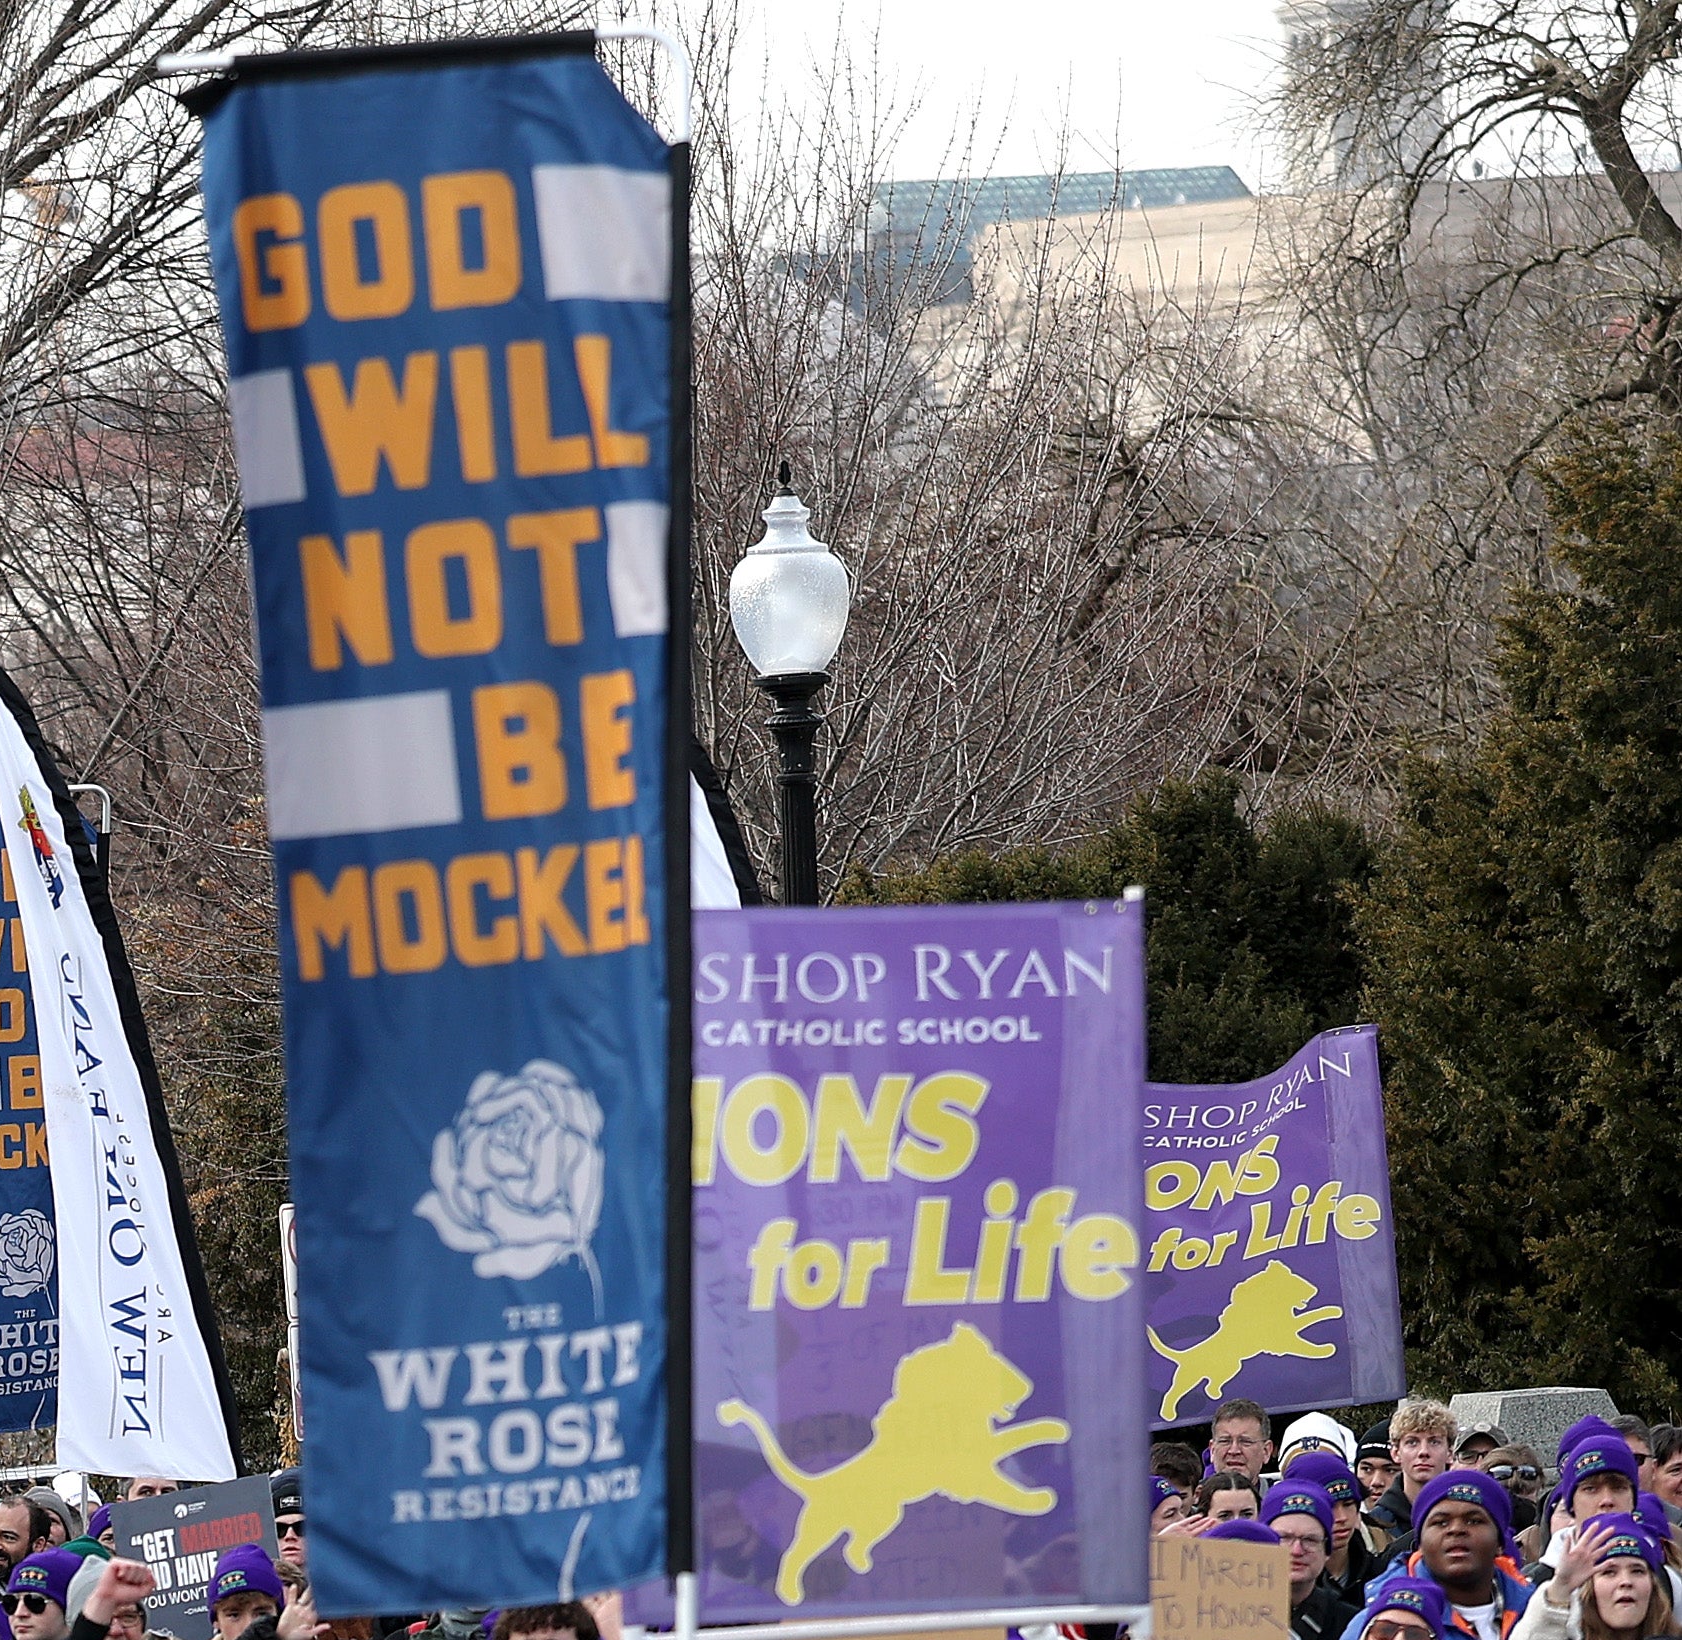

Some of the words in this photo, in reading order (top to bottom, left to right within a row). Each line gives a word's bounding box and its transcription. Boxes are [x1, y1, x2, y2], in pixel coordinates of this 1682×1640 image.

[233, 169, 521, 332] GOD
[305, 334, 649, 496] WILL
[300, 506, 600, 671] NOT
[472, 670, 635, 821] BE
[696, 951, 886, 1004] SHOP
[915, 944, 1113, 1001] RYAN
[702, 1019, 885, 1047] CATHOLIC
[897, 1015, 1041, 1044] SCHOOL
[8, 1055, 43, 1110] B
[1144, 1101, 1258, 1129] SHOP
[1265, 1052, 1351, 1113] RYAN
[1252, 1097, 1306, 1137] SCHOOL
[693, 1071, 991, 1187] IONS
[1145, 1135, 1280, 1211] ONS
[747, 1218, 889, 1310] for
[902, 1180, 1138, 1306] Life
[1147, 1228, 1238, 1272] for
[1243, 1181, 1381, 1261] Life
[14, 1309, 36, 1319] THE
[502, 1304, 561, 1331] THE
[367, 1322, 644, 1412] WHITE
[1151, 1539, 1165, 1581] I
[1180, 1543, 1274, 1590] MARCH
[1151, 1594, 1185, 1629] TO
[1197, 1595, 1286, 1632] HONOR
